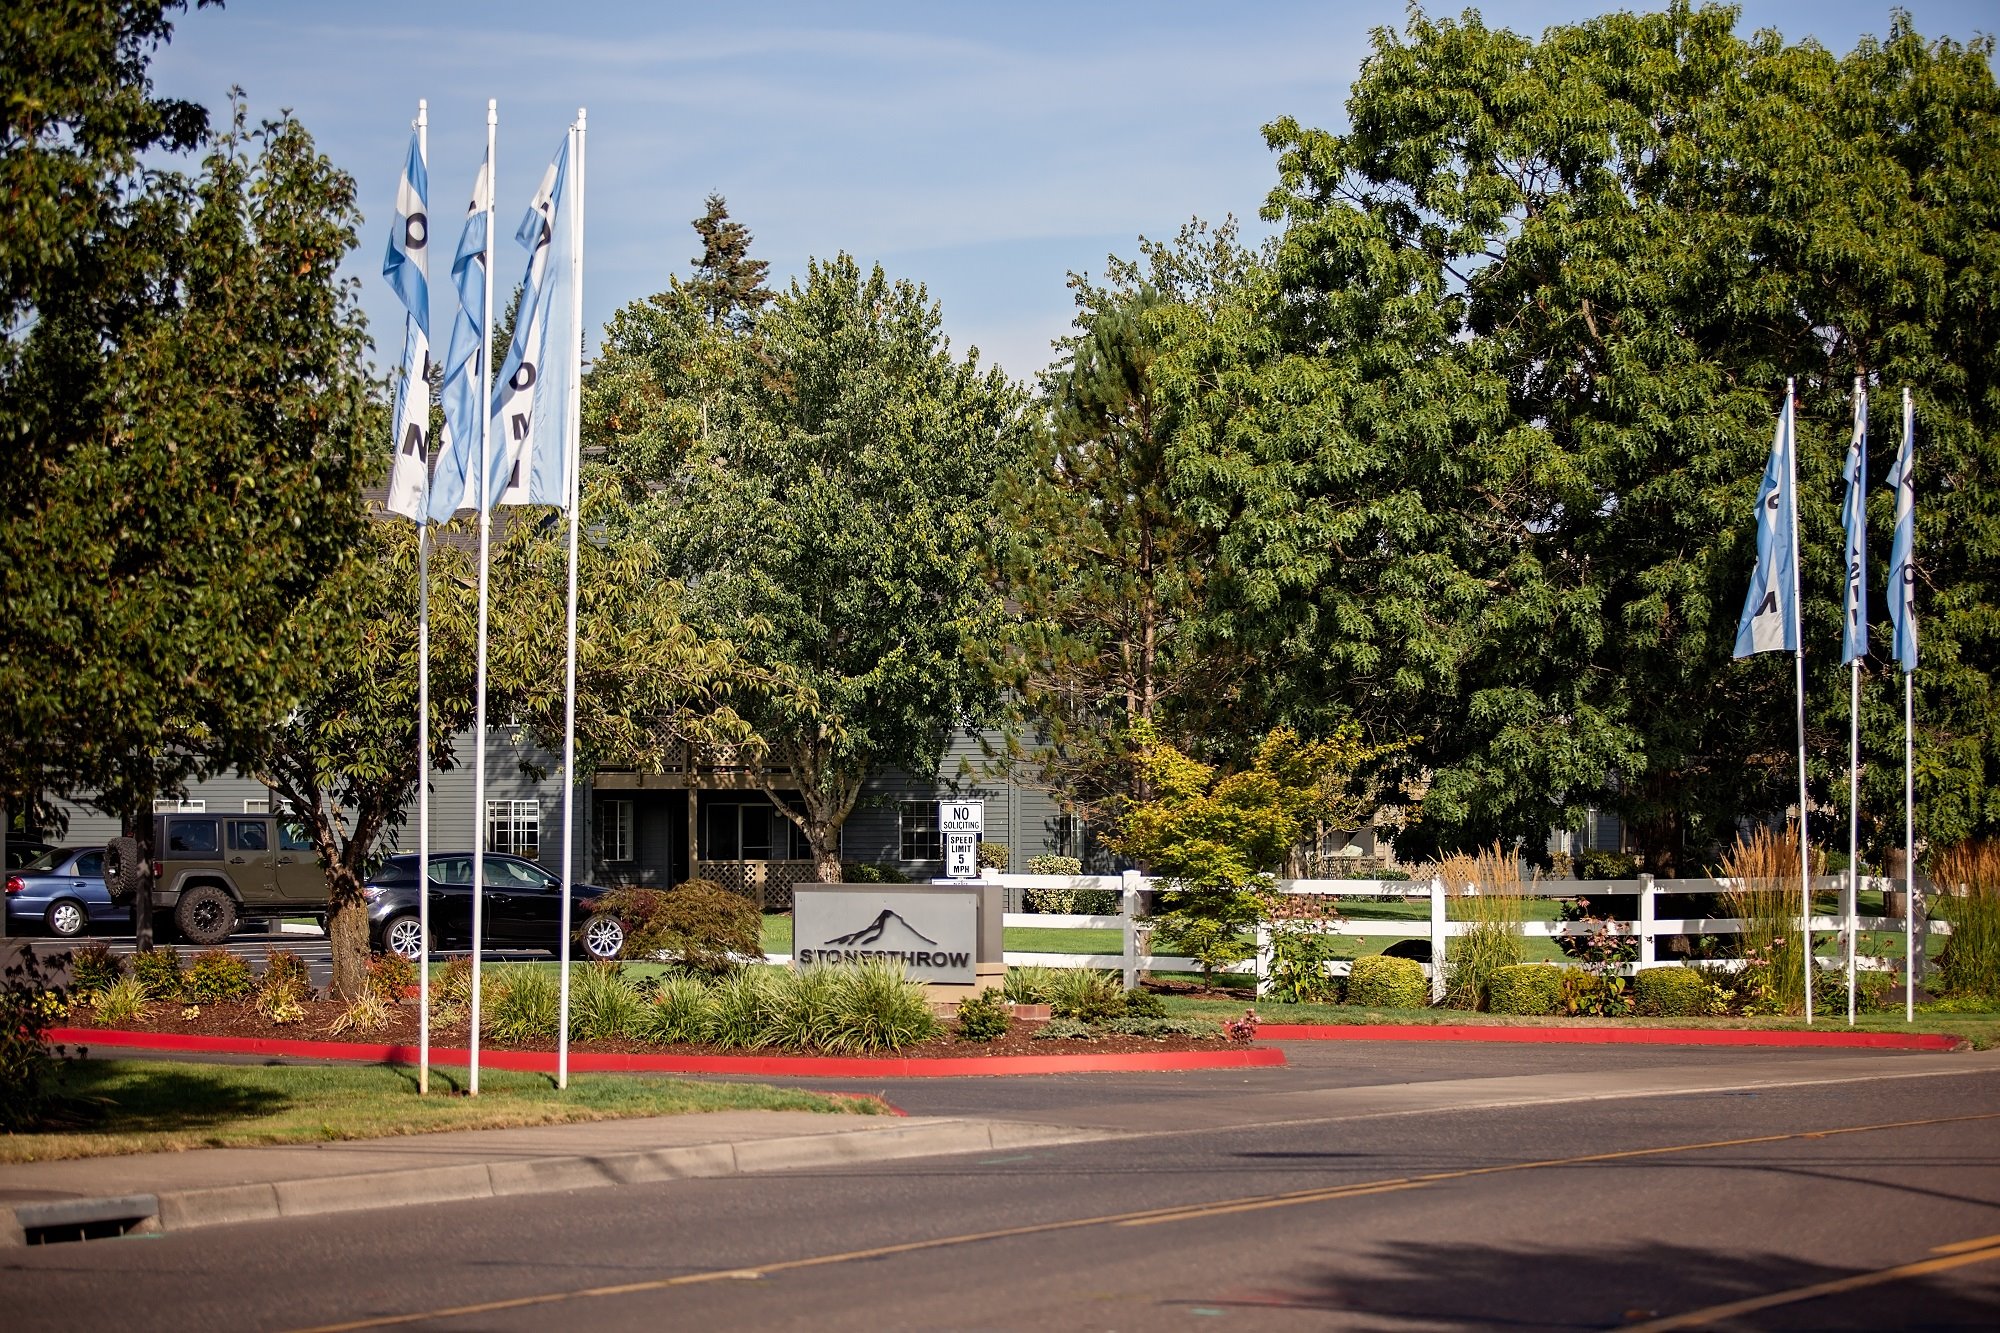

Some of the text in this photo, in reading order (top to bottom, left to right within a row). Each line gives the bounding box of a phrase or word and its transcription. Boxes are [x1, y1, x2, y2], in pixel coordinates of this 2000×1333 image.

[953, 807, 970, 821] NO
[943, 821, 980, 830] SOLICITING
[950, 836, 973, 844] SPEED
[951, 845, 972, 853] LIMIT
[958, 854, 965, 865] 5
[953, 865, 970, 874] MPH
